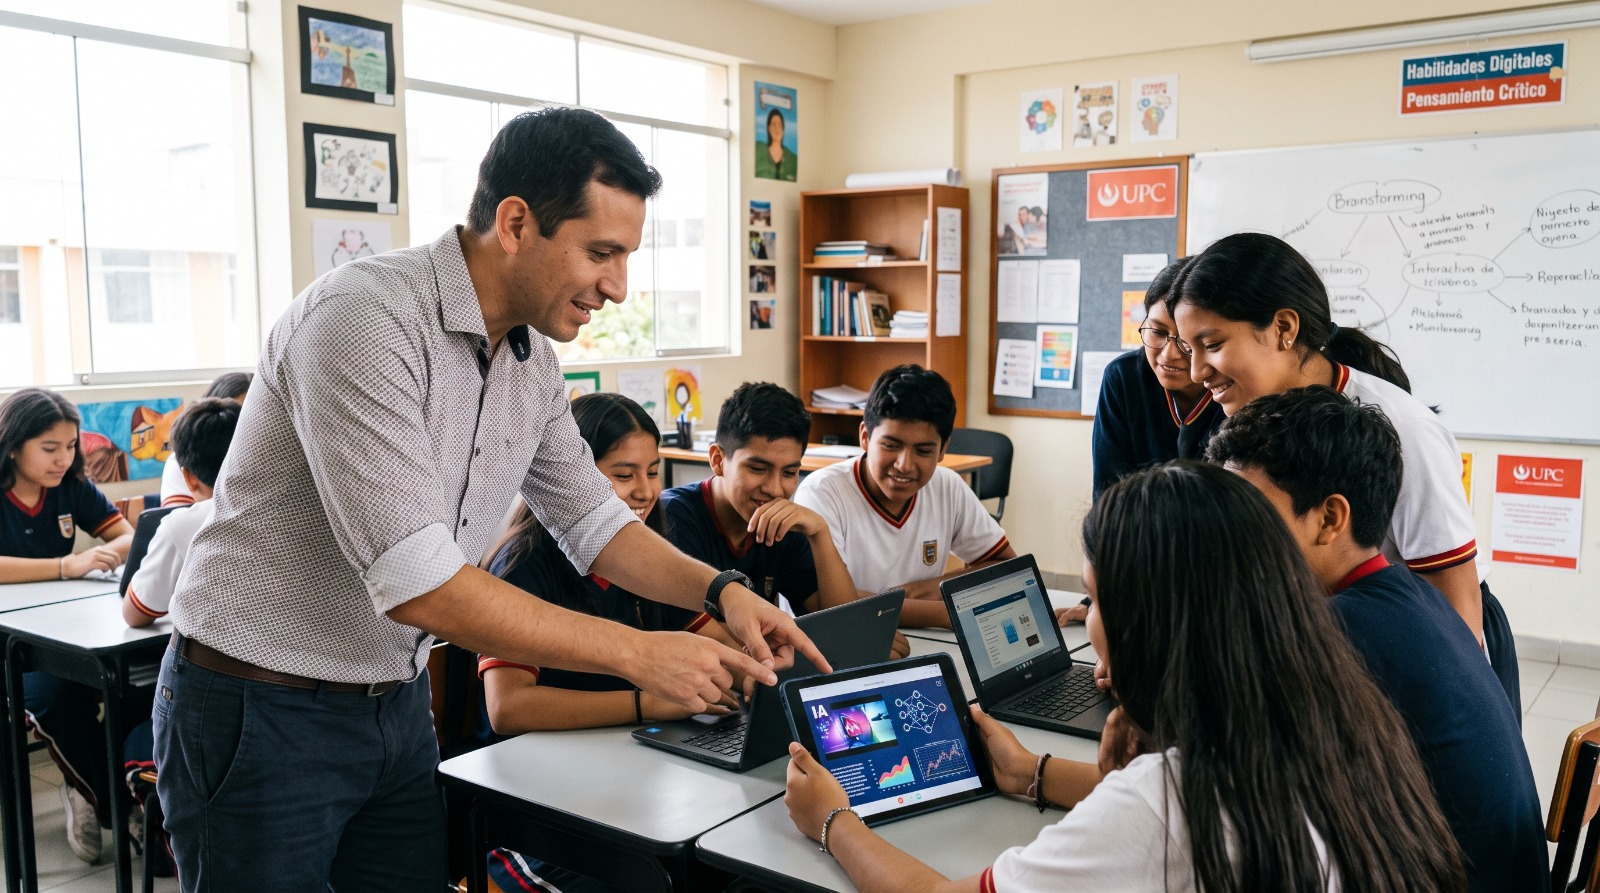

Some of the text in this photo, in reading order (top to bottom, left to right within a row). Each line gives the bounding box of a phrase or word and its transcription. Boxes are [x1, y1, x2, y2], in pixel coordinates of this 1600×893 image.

[1407, 51, 1553, 80] Habilidades Digitales
[1406, 82, 1547, 108] Pensamiento Crítico
[1122, 182, 1167, 204] UPC
[1334, 188, 1425, 214] Brainstorming
[1531, 467, 1564, 482] UPC
[811, 704, 829, 719] IA
